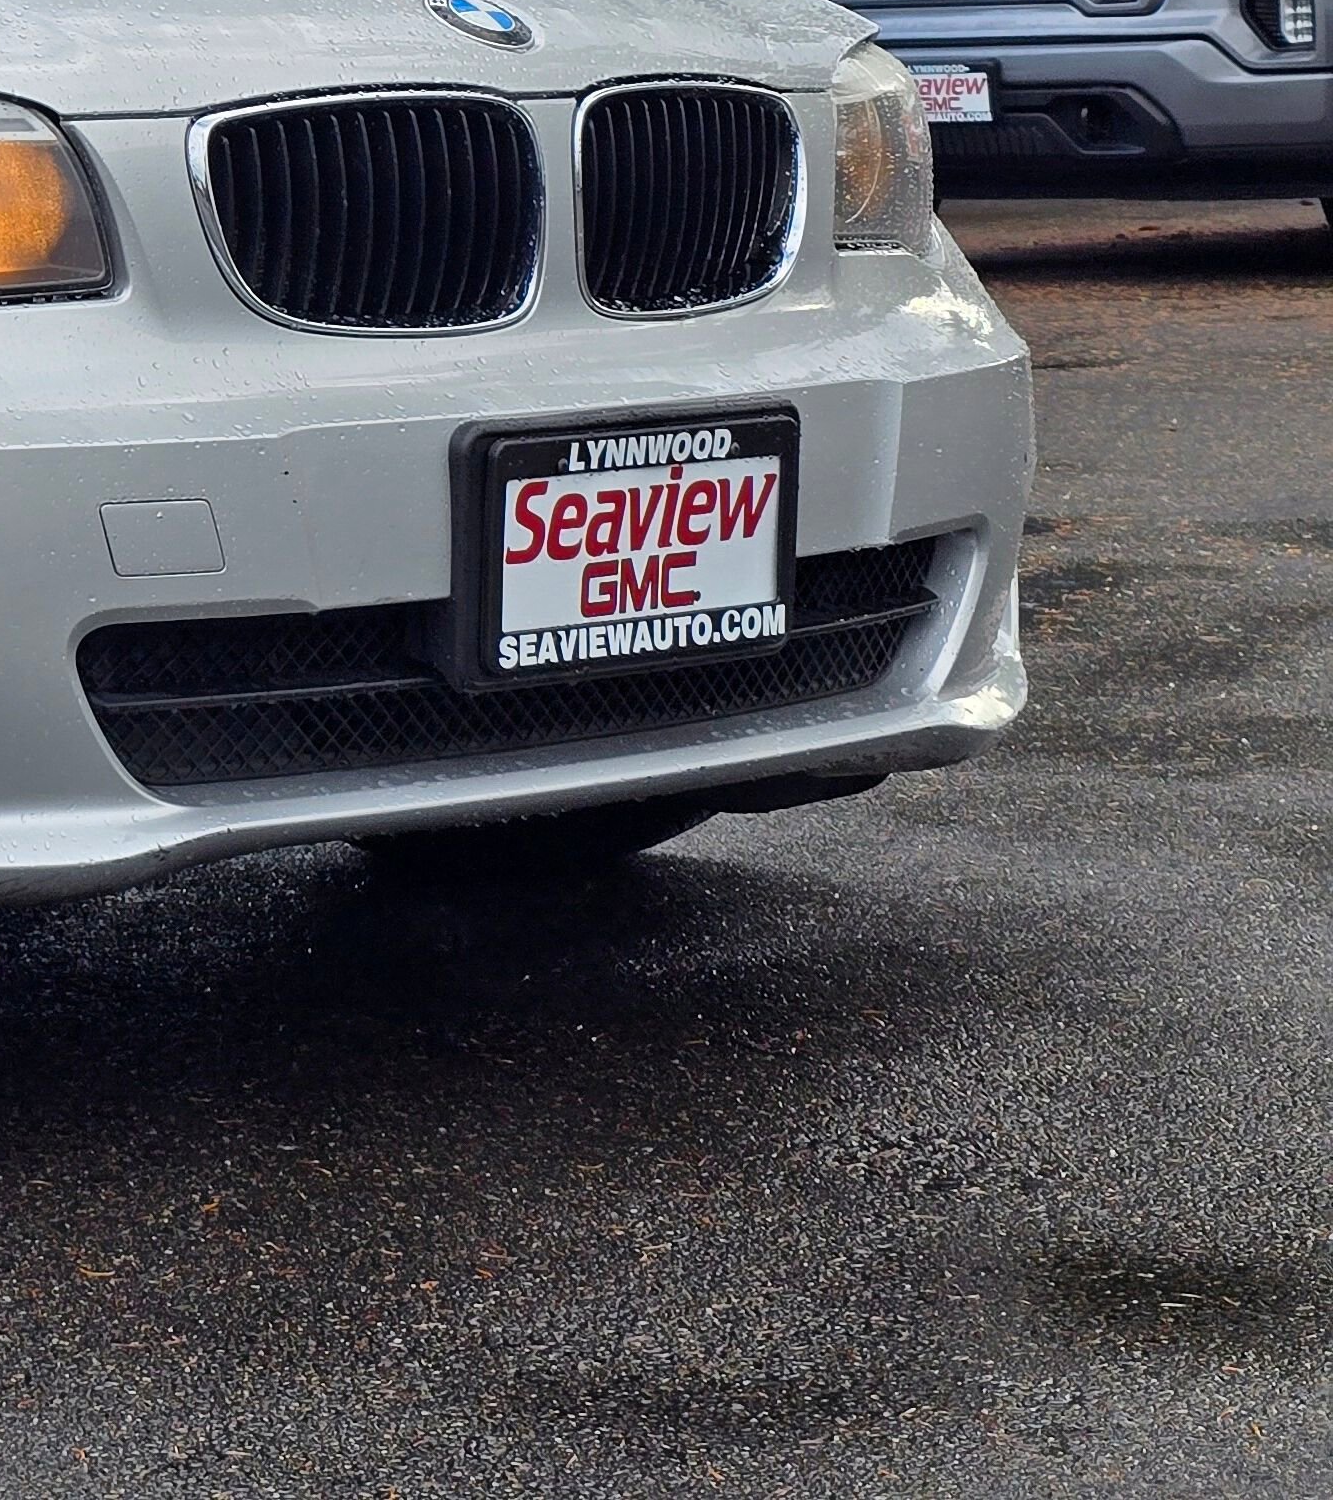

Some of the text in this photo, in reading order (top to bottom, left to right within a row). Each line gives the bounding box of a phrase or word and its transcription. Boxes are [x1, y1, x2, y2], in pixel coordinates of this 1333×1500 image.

[913, 73, 987, 96] aview
[567, 428, 733, 472] LYNNWOOD
[504, 465, 779, 565] Seaview
[580, 550, 699, 619] GMC
[497, 603, 787, 670] SEAVIEWAUTO.COM
